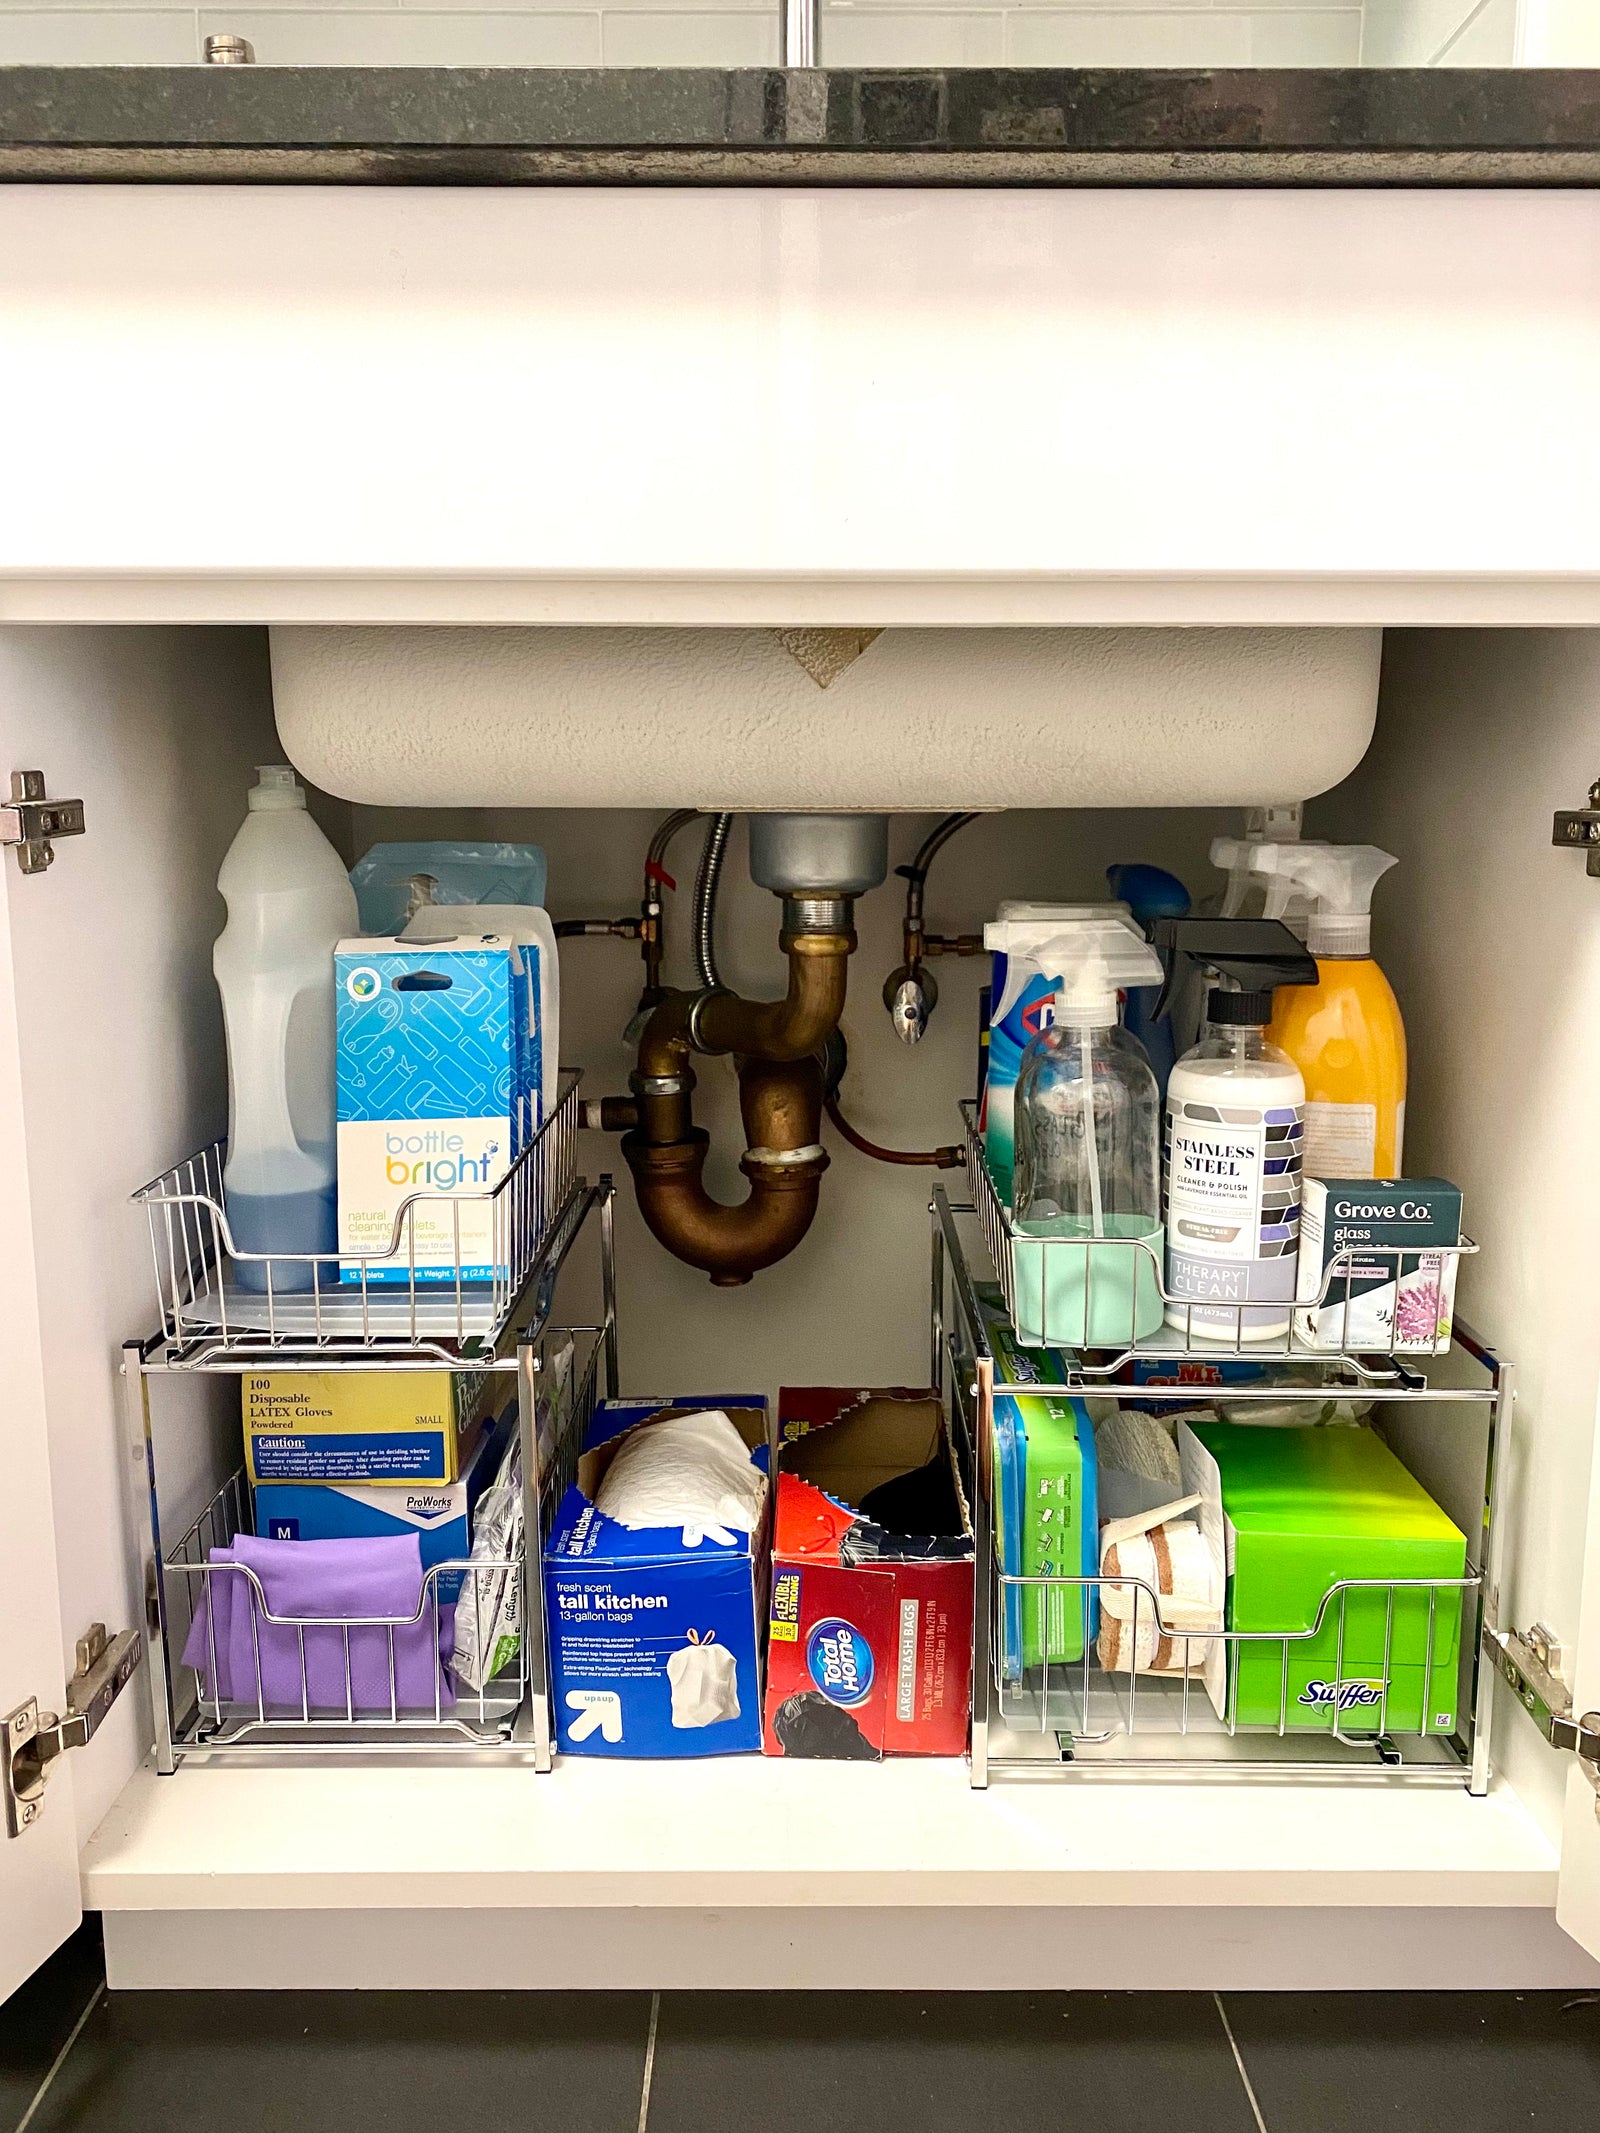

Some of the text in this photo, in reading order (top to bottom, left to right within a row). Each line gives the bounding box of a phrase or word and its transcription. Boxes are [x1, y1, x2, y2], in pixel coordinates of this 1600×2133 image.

[386, 1130, 464, 1154] bottle
[1175, 1137, 1255, 1159] STAINLESS
[386, 1153, 491, 1191] bright
[1184, 1155, 1240, 1176] STEEL
[1177, 1175, 1248, 1191] CLEANER & POLISH
[1185, 1187, 1209, 1195] LAVENDER
[1210, 1191, 1237, 1199] ESSENTIAL
[348, 1209, 386, 1221] natural
[1334, 1201, 1432, 1219] Grove Co.
[348, 1219, 395, 1233] cleaning
[1334, 1227, 1371, 1242] glass
[424, 1270, 450, 1279] Weight
[1176, 1261, 1240, 1282] THERAPY
[1175, 1275, 1238, 1298] CLEAN
[250, 1380, 271, 1390] 100
[250, 1394, 311, 1406] Disposable
[250, 1407, 333, 1417] LATEX Gloves
[1050, 1409, 1066, 1420] 12
[251, 1421, 293, 1429] Powdered
[415, 1415, 444, 1425] SMALL
[259, 1437, 306, 1449] Caution:
[406, 1496, 452, 1507] ProWorks
[277, 1527, 291, 1539] M
[566, 1507, 595, 1556] tall kitchen
[556, 1582, 612, 1593] fresh scent
[789, 1575, 800, 1613] STRONG
[505, 1585, 519, 1622] Length
[558, 1593, 668, 1610] tall kitchen
[774, 1574, 791, 1621] FLEXIBLE
[559, 1611, 633, 1623] 13-gallon bags
[785, 1627, 792, 1636] 30
[819, 1637, 842, 1687] Total
[836, 1629, 859, 1692] Home
[899, 1604, 916, 1719] LARGE TRASH BAGS
[923, 1670, 932, 1687] Gallon
[1298, 1681, 1384, 1709] Swiffer
[921, 1712, 931, 1720] 25
